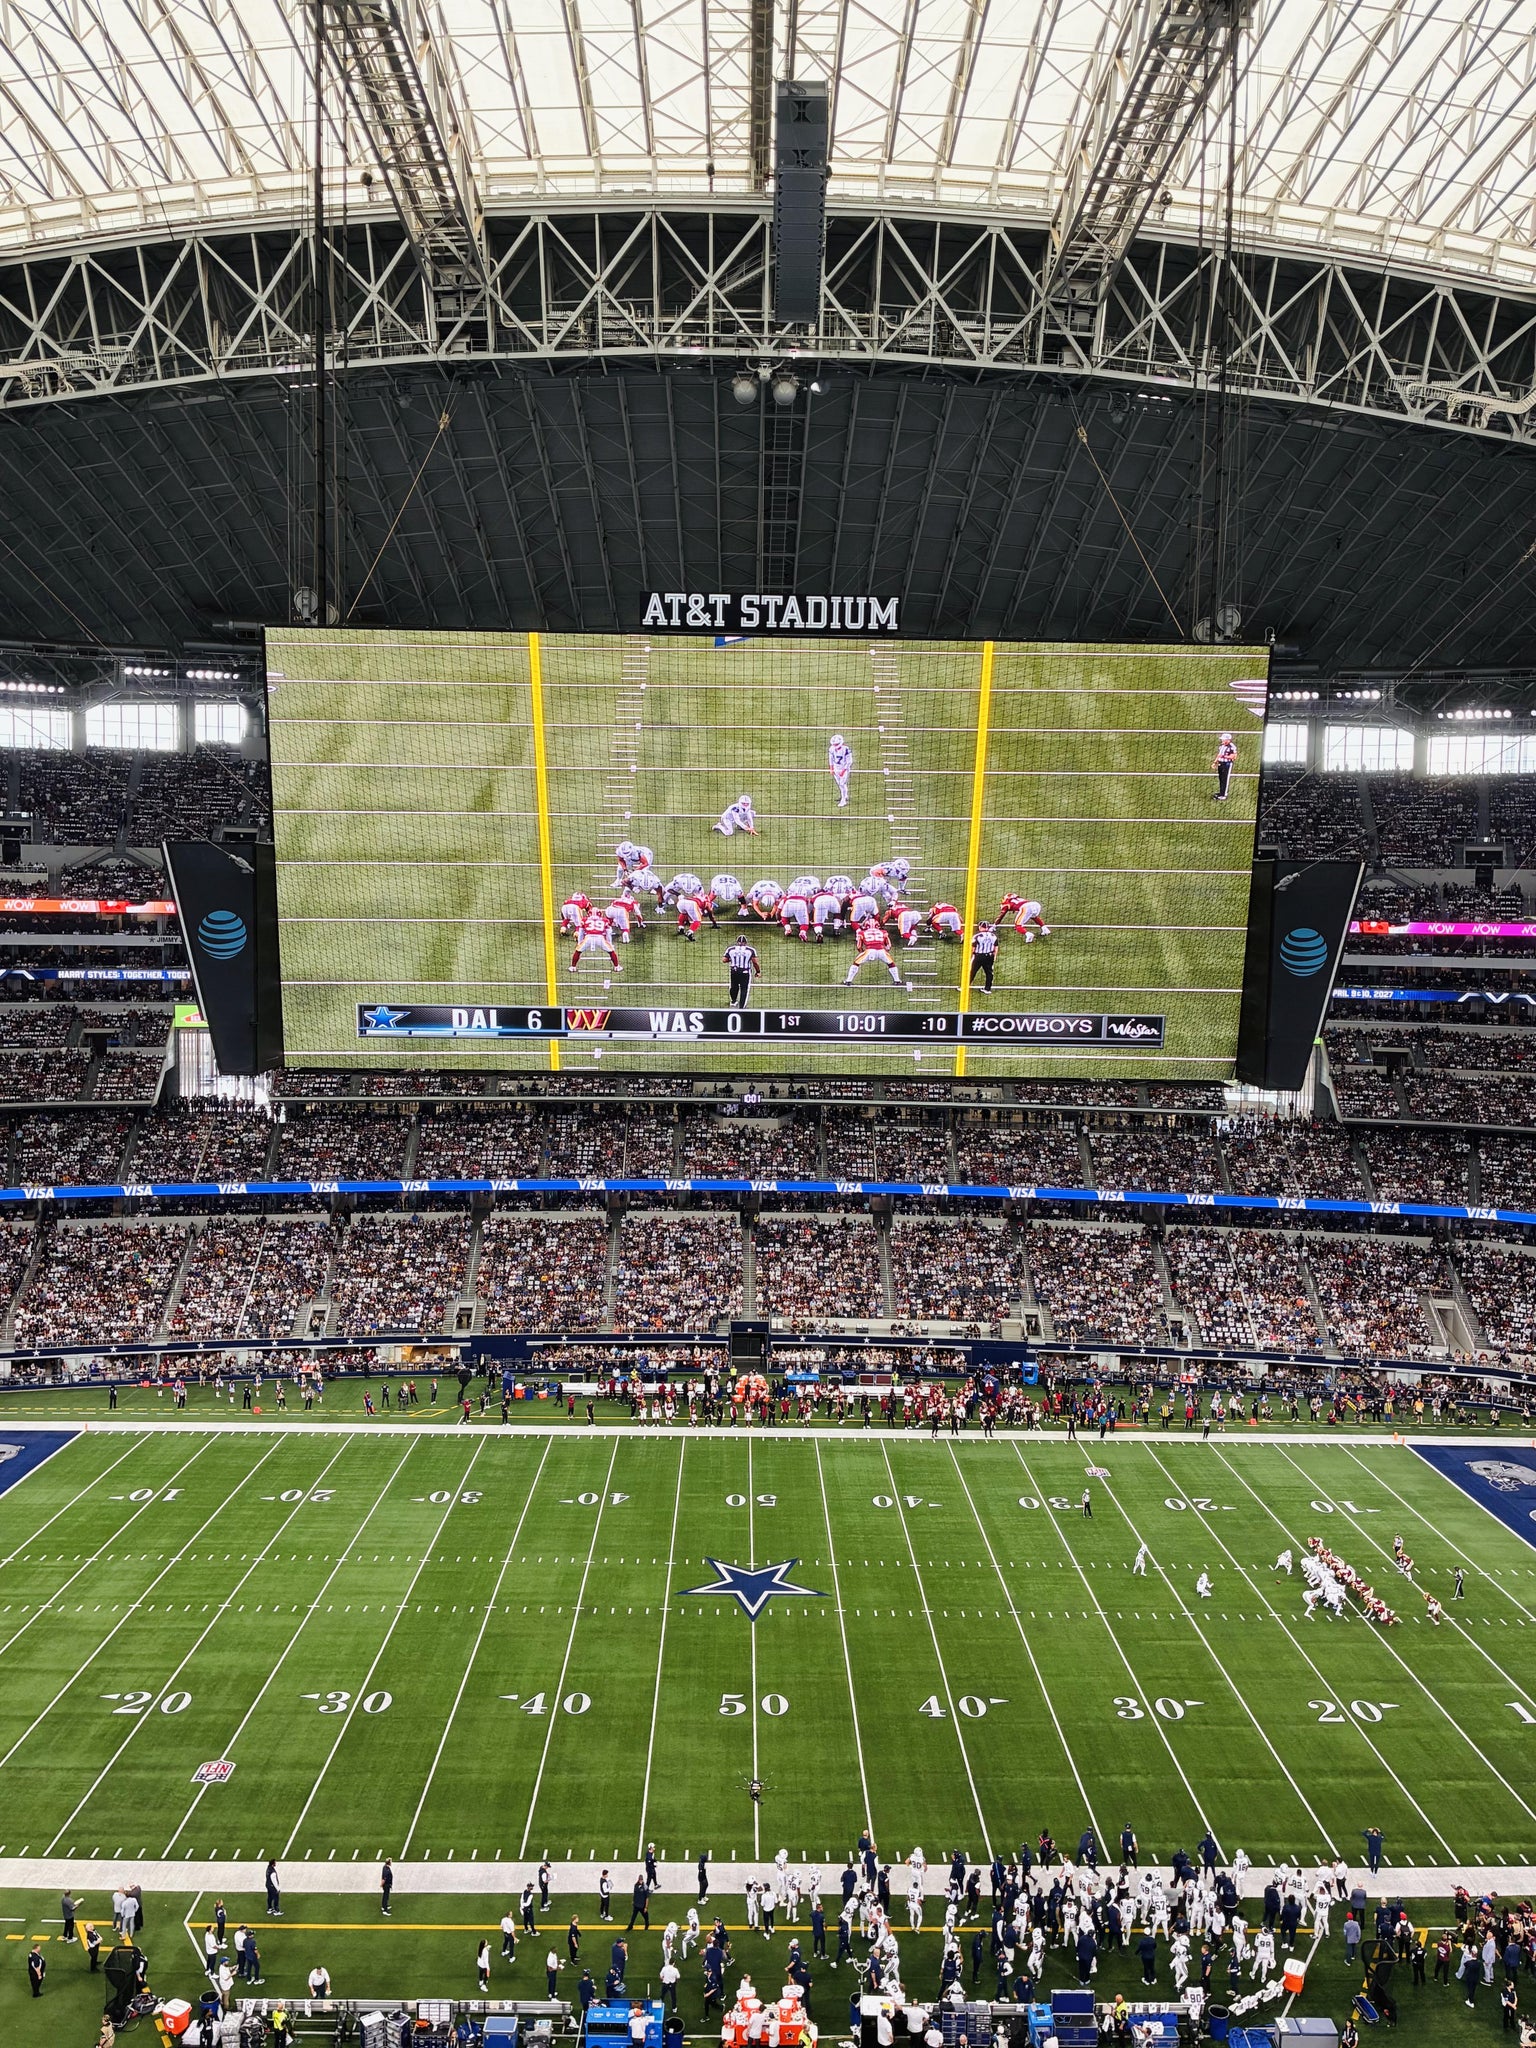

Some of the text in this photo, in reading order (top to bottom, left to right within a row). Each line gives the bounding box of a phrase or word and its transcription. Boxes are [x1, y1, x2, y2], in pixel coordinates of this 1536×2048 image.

[642, 592, 899, 630] AT&T STADIUM
[4, 900, 35, 911] WOW
[59, 900, 89, 911] WOW
[1428, 923, 1456, 934] NOW
[1472, 923, 1501, 935] NOW
[156, 936, 178, 944] JIMMY
[58, 970, 85, 979] HARRY
[1373, 990, 1393, 999] 2027
[452, 1008, 502, 1029] DAL
[527, 1010, 542, 1030] 6
[649, 1011, 704, 1033] WAS
[727, 1013, 741, 1033] 0
[836, 1014, 886, 1033] 10:01
[922, 1017, 947, 1031] :10
[972, 1017, 1093, 1033] #COWBOYS
[1108, 1018, 1160, 1038] WinStar
[122, 1185, 153, 1197] VISA
[217, 1183, 247, 1194] VISA
[309, 1182, 339, 1193] VISA
[400, 1181, 430, 1192] VISA
[490, 1180, 519, 1191] VISA
[578, 1180, 606, 1191] VISA
[663, 1180, 692, 1191] VISA
[749, 1180, 778, 1191] VISA
[834, 1182, 863, 1193] VISA
[920, 1184, 949, 1195] VISA
[23, 1187, 55, 1199] VISA
[1007, 1186, 1036, 1198] VISA
[1095, 1190, 1125, 1202] VISA
[1185, 1194, 1215, 1205] VISA
[1276, 1197, 1306, 1209] VISA
[1370, 1202, 1401, 1214] VISA
[1465, 1207, 1498, 1220] VISA
[165, 2017, 175, 2029] G
